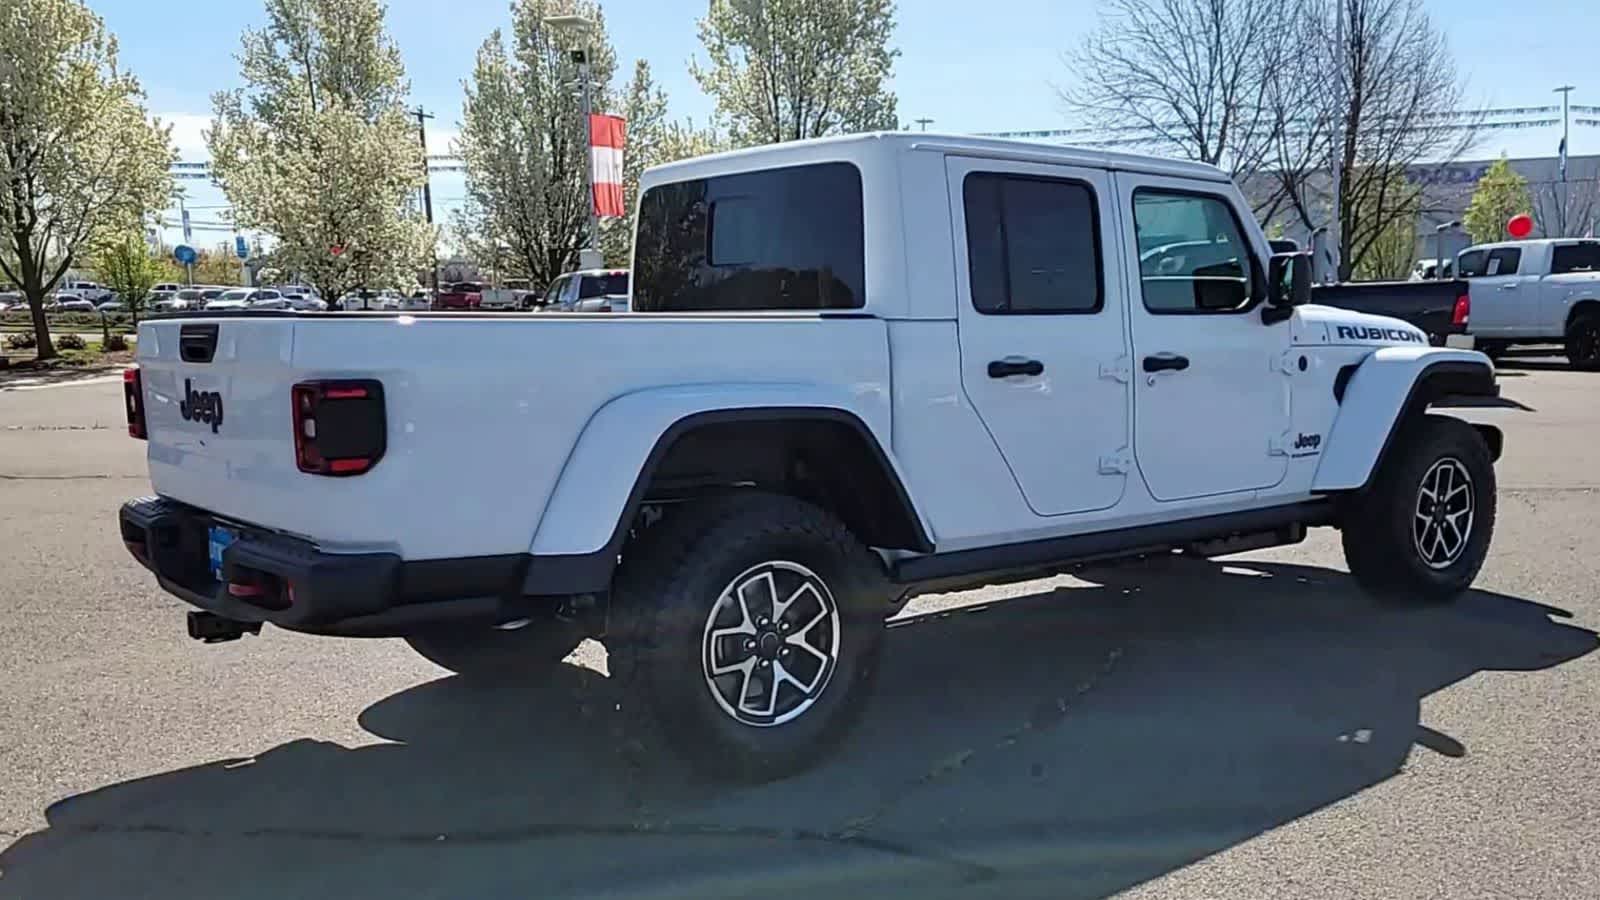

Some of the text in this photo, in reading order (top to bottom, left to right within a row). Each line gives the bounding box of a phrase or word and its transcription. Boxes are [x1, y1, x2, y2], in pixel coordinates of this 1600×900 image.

[1336, 325, 1423, 343] RUBICON
[180, 377, 224, 435] Jeep
[1294, 432, 1321, 449] Jeep
